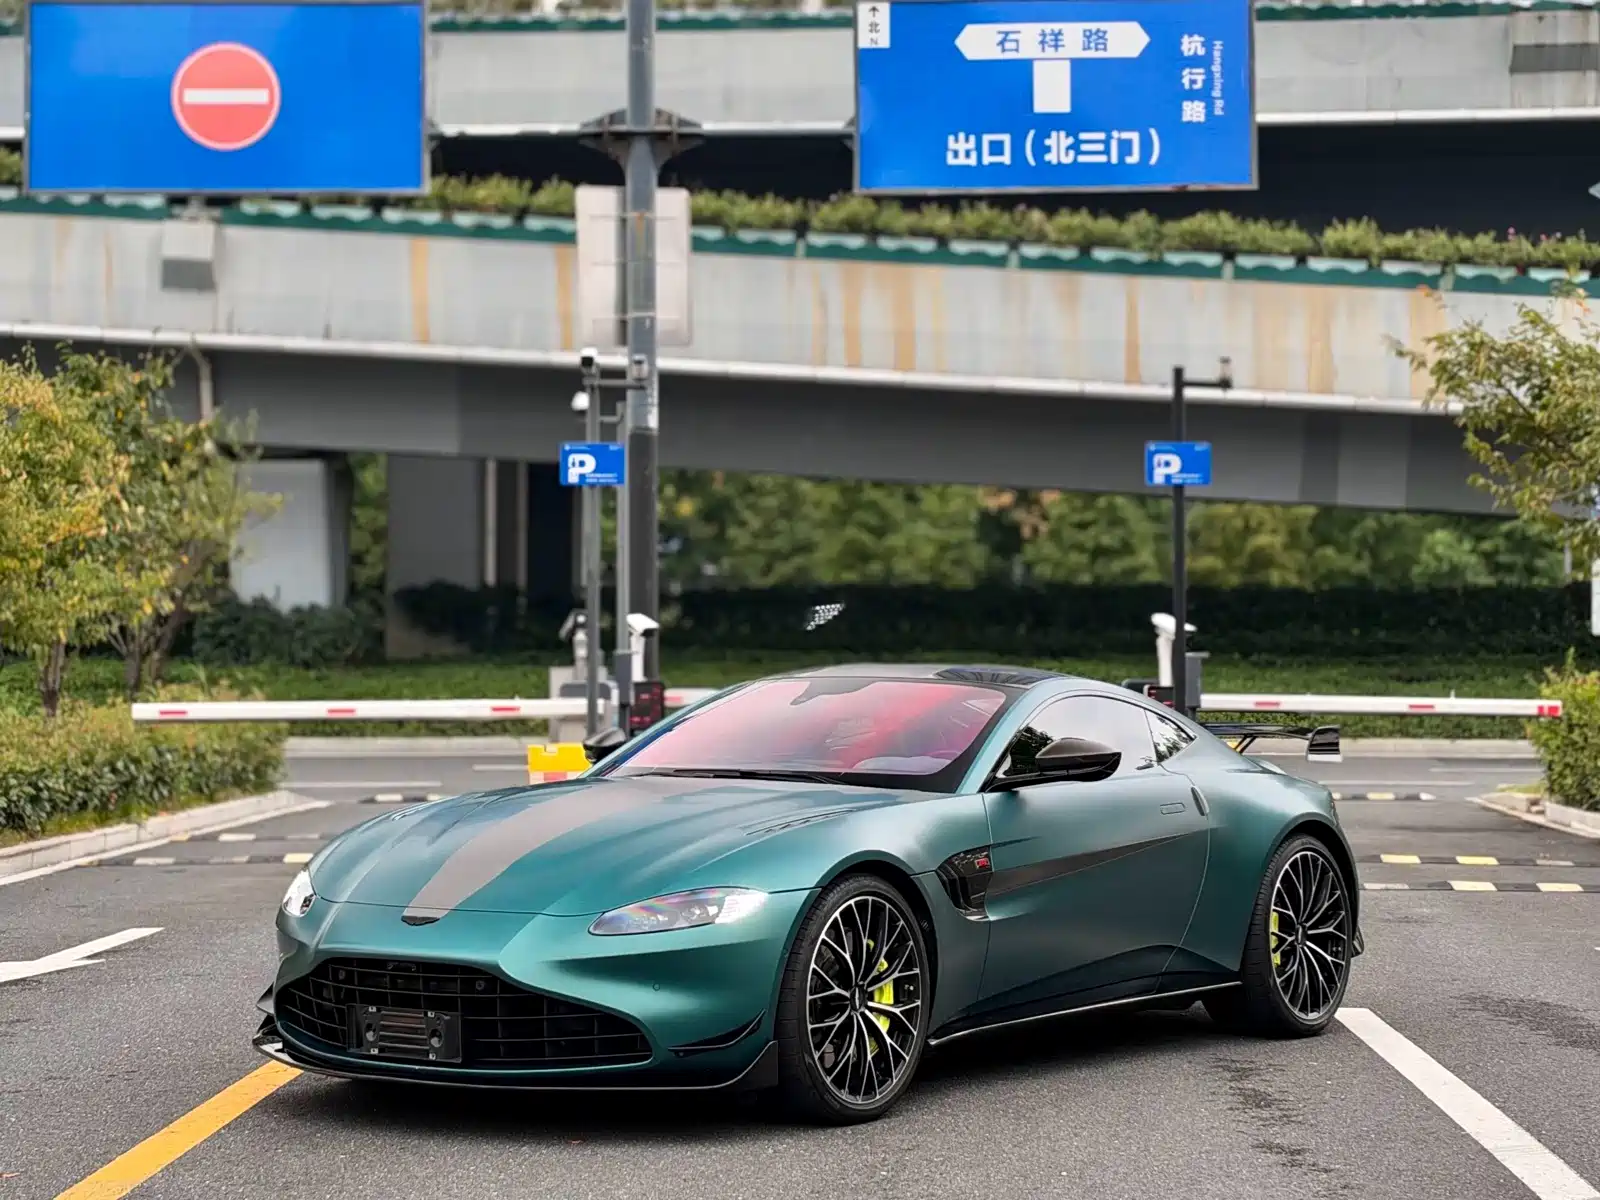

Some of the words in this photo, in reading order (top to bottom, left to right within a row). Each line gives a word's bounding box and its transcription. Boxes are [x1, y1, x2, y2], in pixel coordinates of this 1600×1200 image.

[868, 20, 881, 33] 北
[995, 27, 1109, 54] 石祥路
[1180, 33, 1206, 123] 杭行路
[1211, 40, 1224, 97] Hangxing
[1213, 99, 1225, 115] Rd
[567, 453, 597, 484] P
[1152, 453, 1182, 485] P
